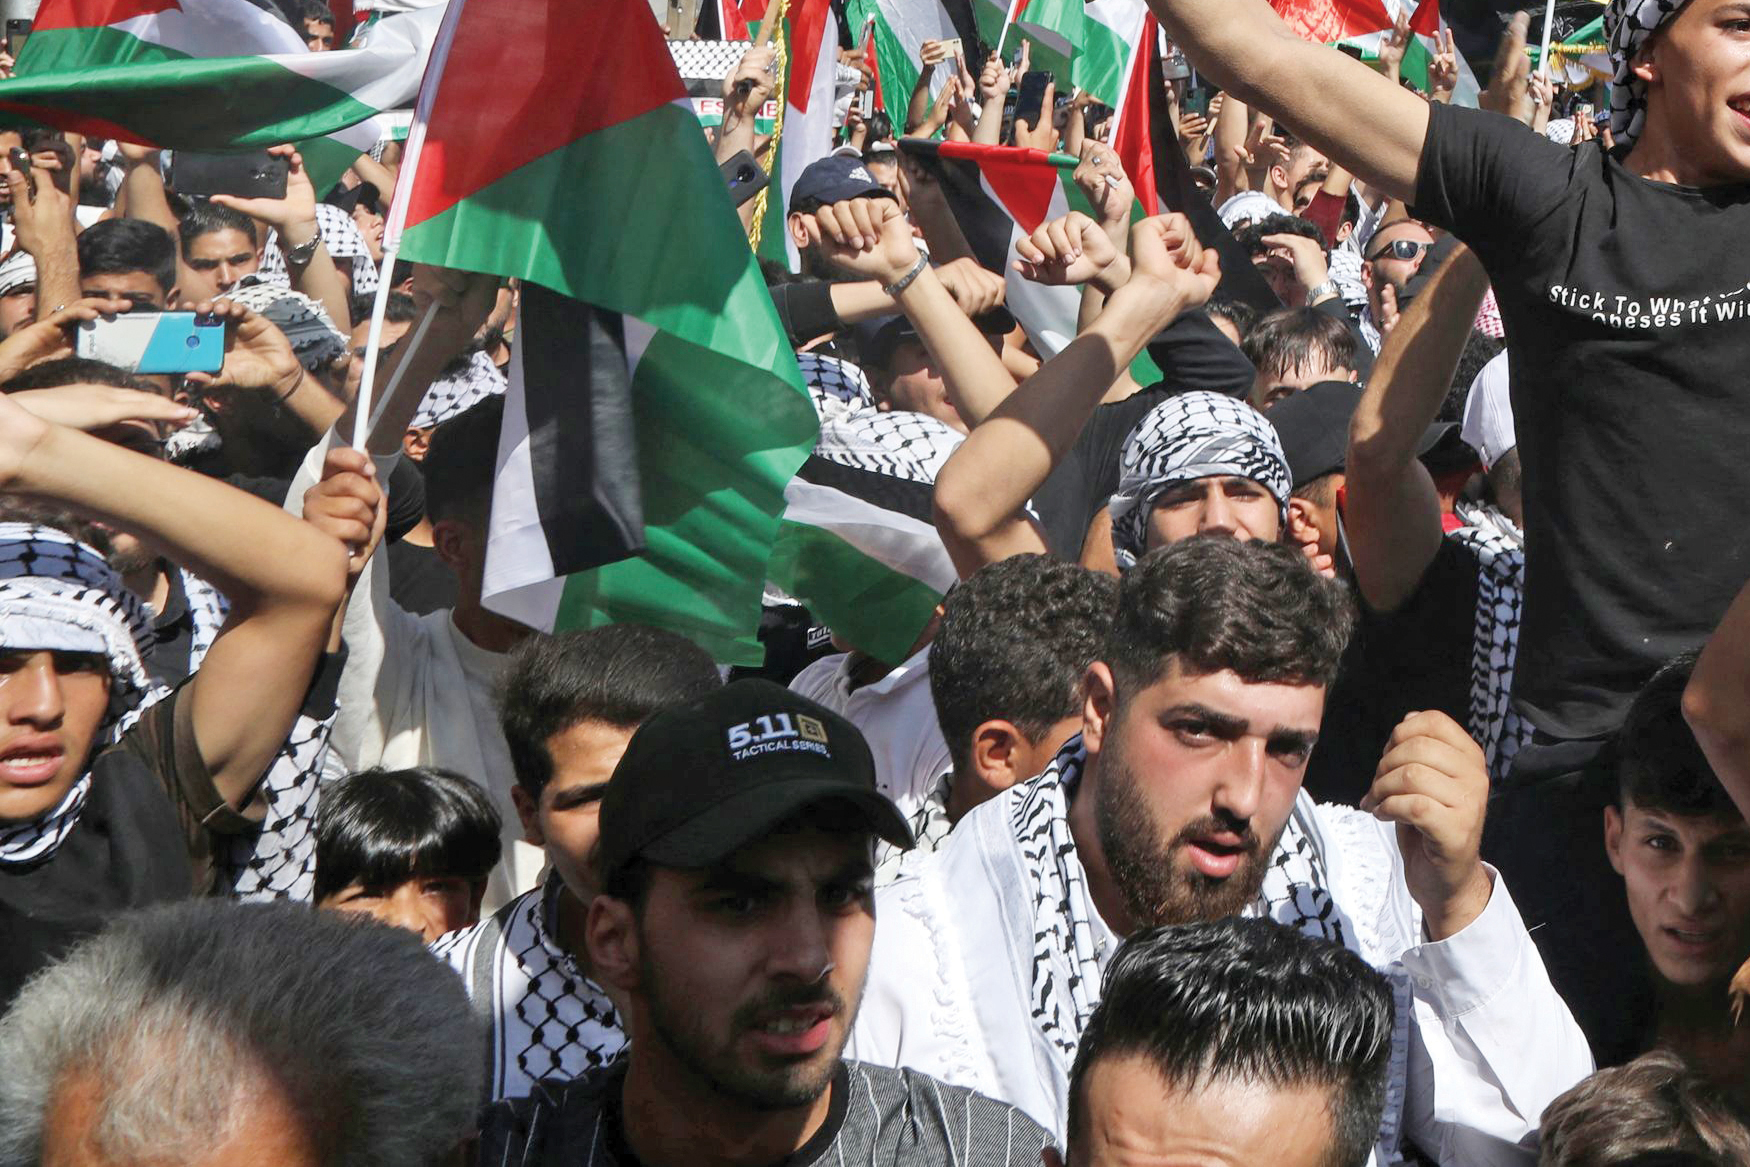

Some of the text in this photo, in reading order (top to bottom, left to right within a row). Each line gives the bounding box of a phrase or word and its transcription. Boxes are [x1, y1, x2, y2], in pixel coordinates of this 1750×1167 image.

[1549, 285, 1608, 311] Stick
[1615, 295, 1641, 316] To
[728, 713, 799, 749] 5.11
[732, 739, 792, 760] TACTICAL
